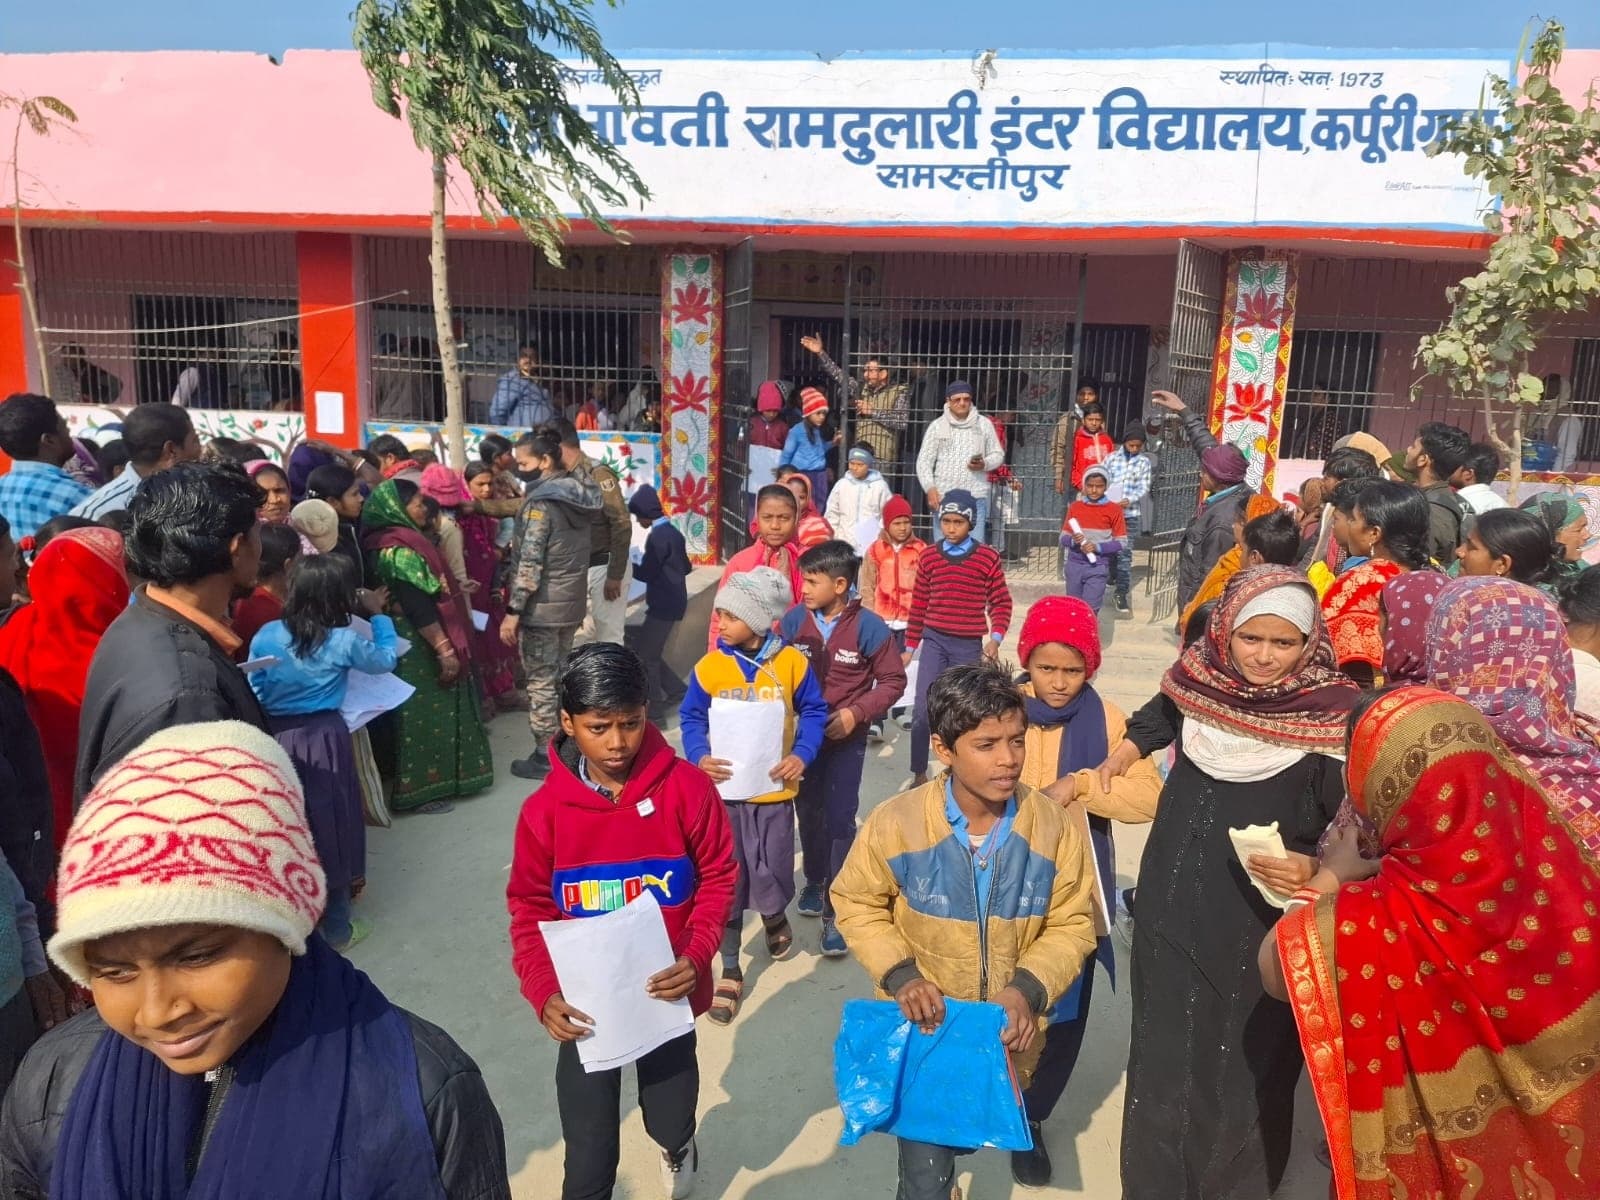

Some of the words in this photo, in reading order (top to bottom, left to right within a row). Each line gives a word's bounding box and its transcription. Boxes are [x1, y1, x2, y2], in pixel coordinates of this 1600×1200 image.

[1339, 71, 1384, 89] 1973
[744, 89, 982, 166] रामदुलारी
[990, 95, 1086, 157] इंटर
[876, 157, 1071, 202] समस्तीपुर
[562, 875, 643, 912] PUMA
